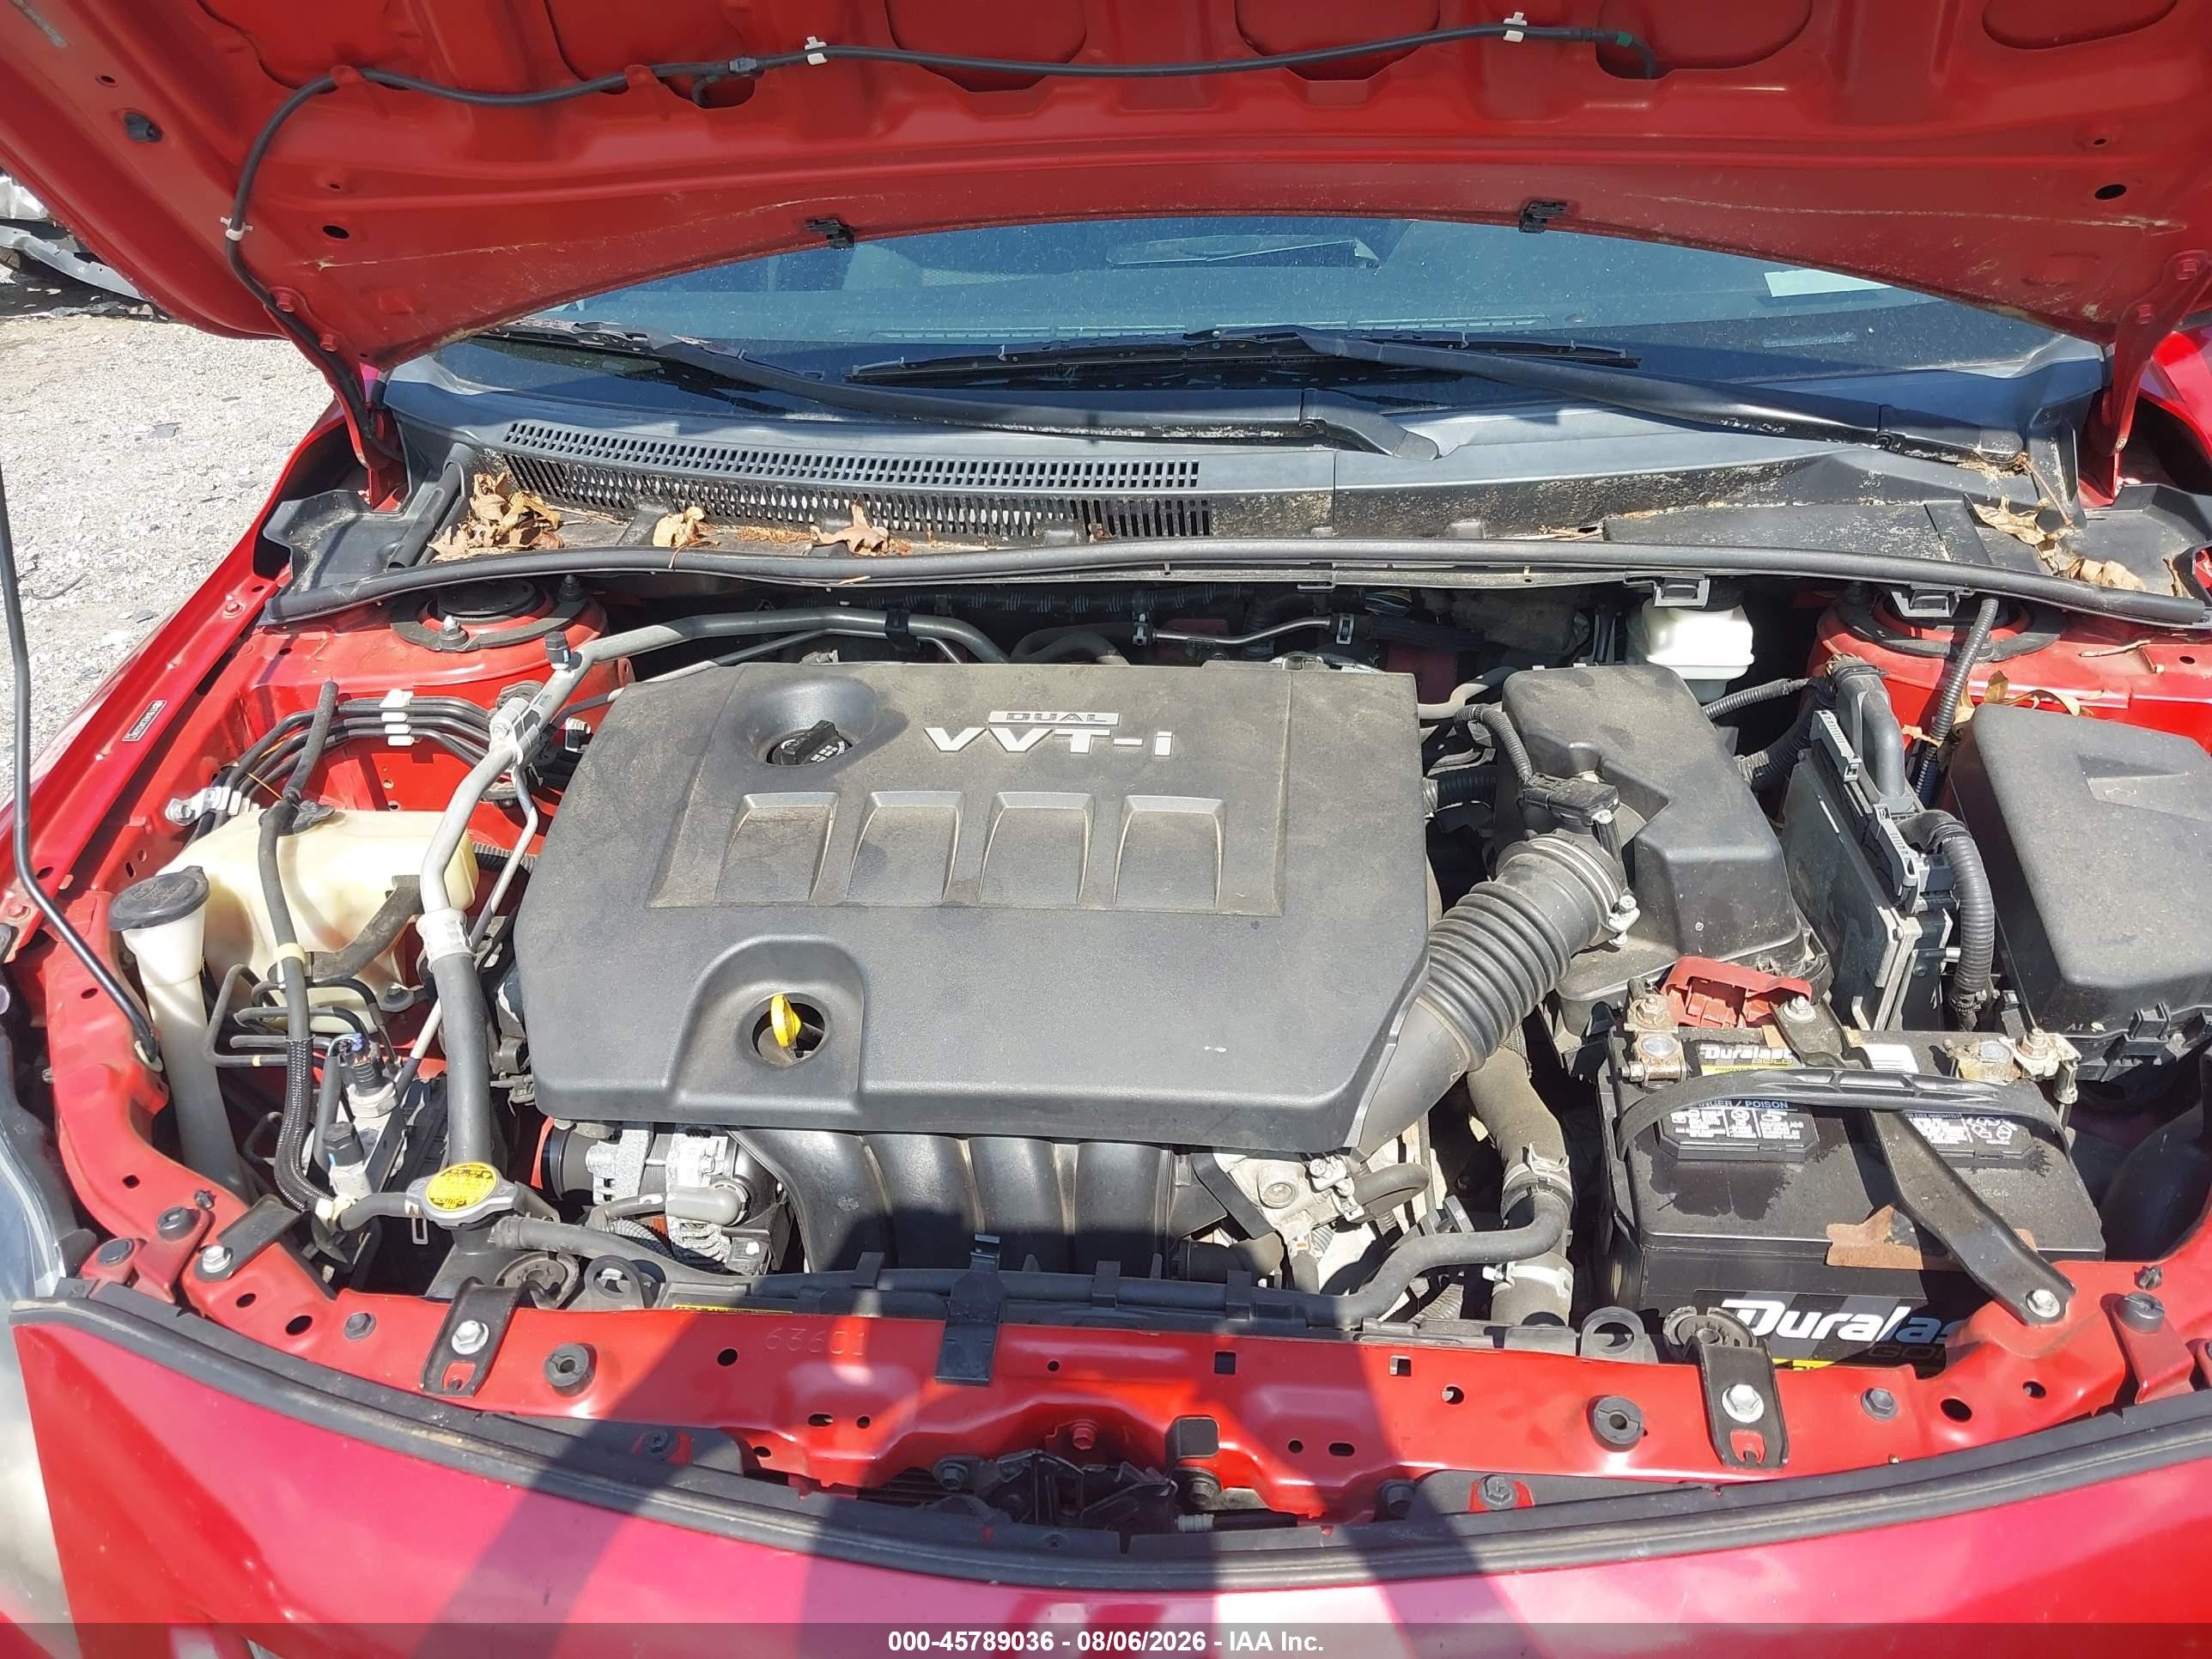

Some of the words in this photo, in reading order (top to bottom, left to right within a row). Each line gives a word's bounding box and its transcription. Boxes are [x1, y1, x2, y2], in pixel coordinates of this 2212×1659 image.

[1006, 712, 1108, 723] DUAL
[923, 726, 1174, 757] VVT-i
[1699, 1043, 1793, 1060] Duralast
[1745, 1100, 1789, 1109] POISON
